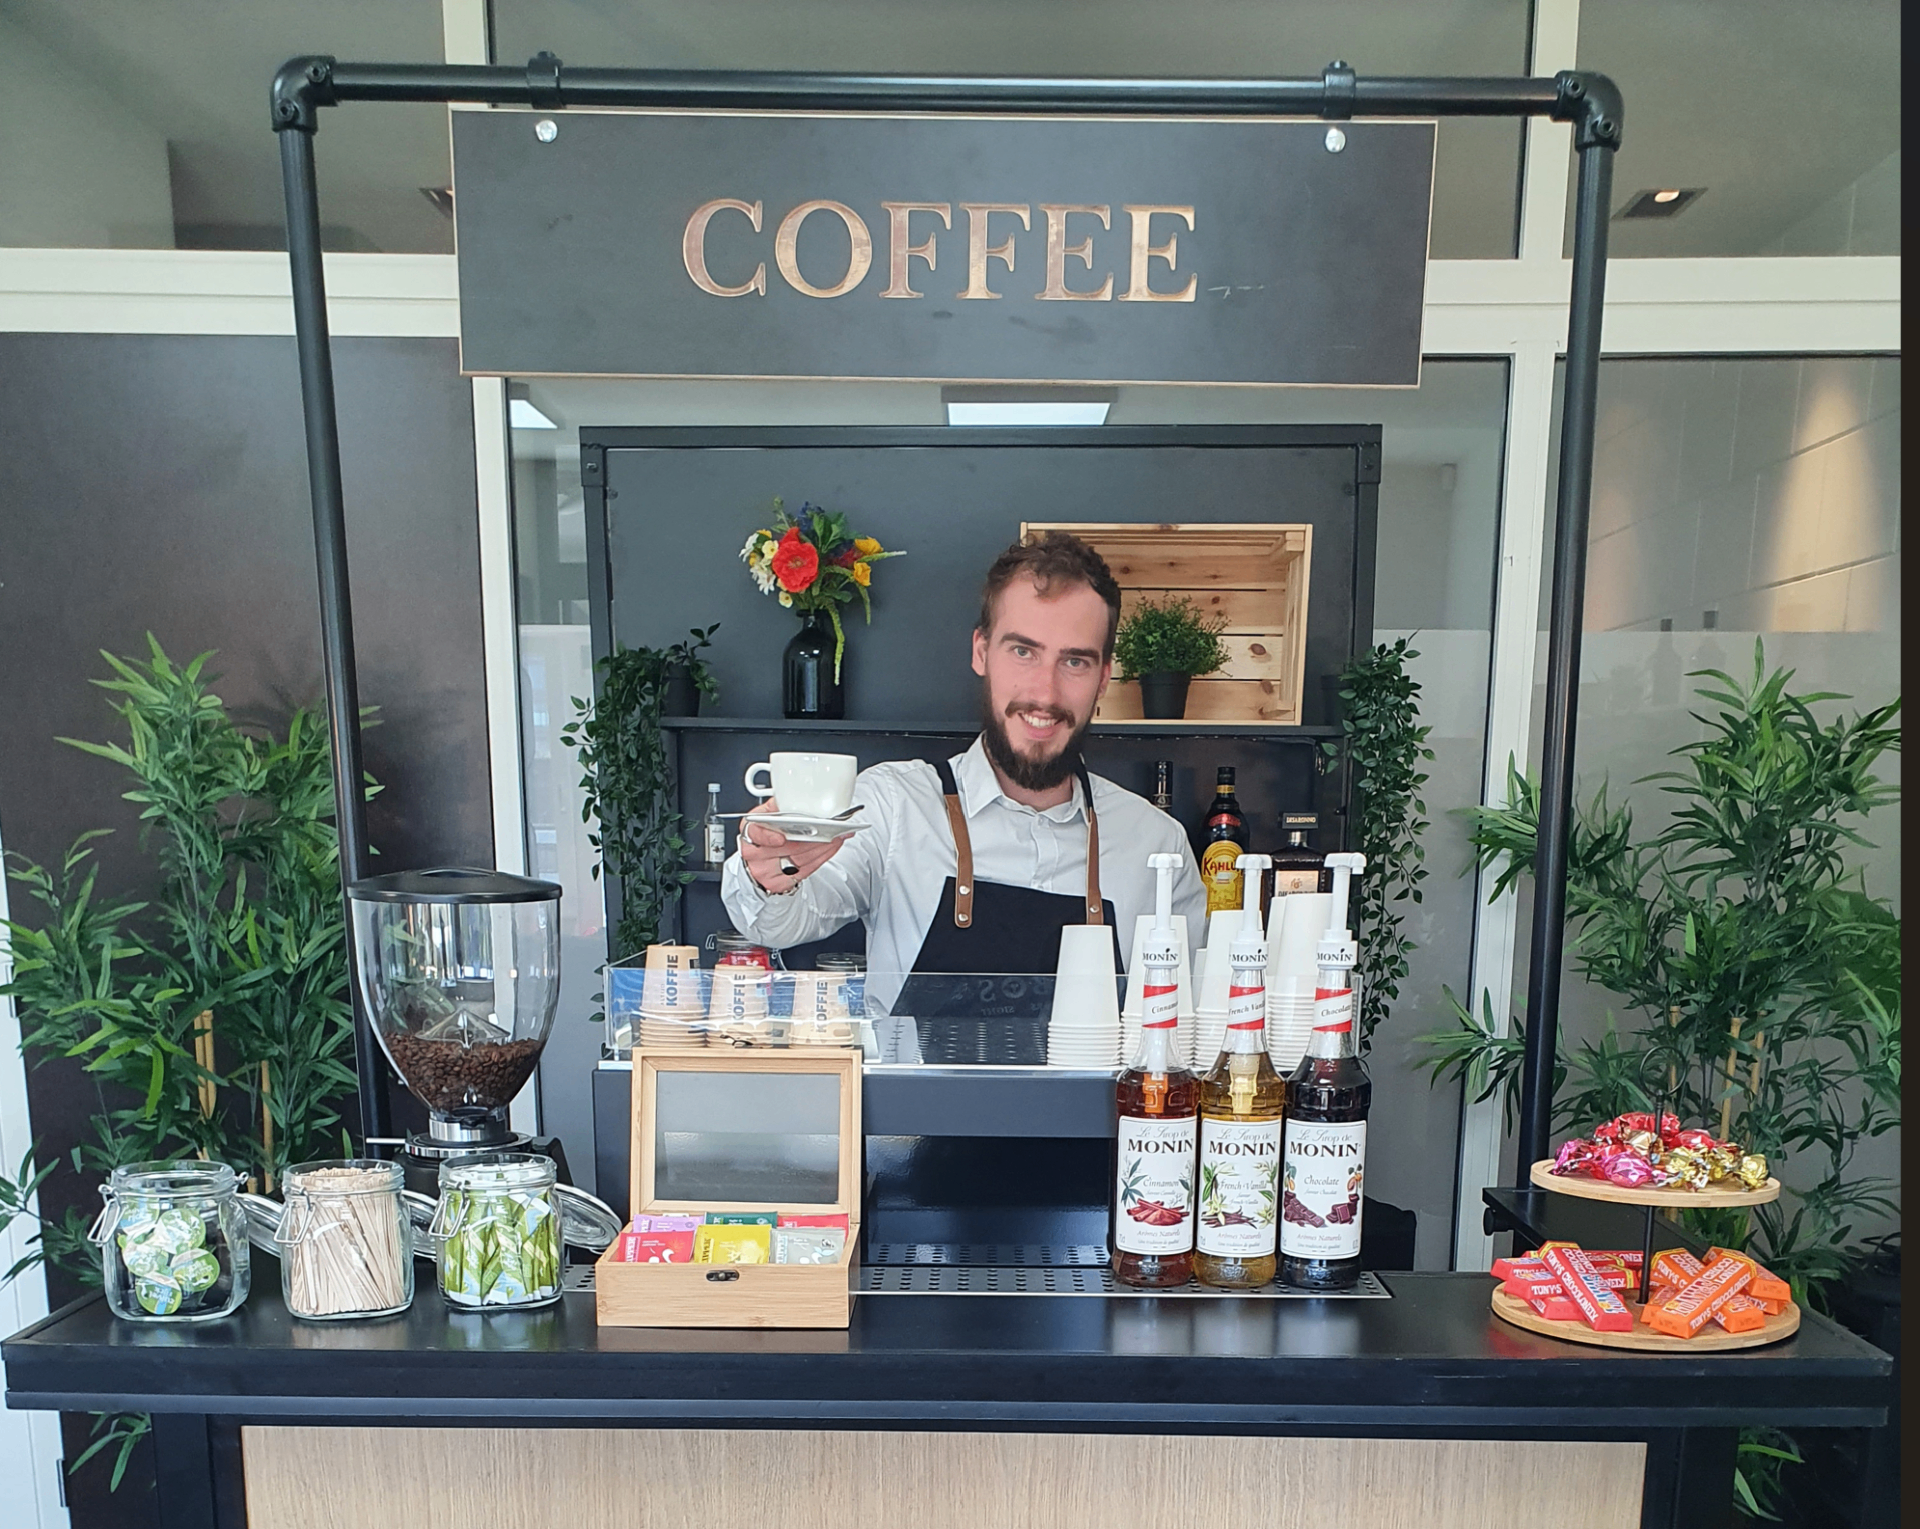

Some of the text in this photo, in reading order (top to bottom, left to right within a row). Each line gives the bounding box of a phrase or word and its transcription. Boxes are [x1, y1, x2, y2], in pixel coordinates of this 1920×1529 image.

[683, 198, 1198, 302] COFFEE
[1143, 950, 1176, 962] MONIN
[1232, 950, 1267, 963] MONIN
[1317, 950, 1351, 962] MONIN
[666, 954, 679, 1007] KOFFIE
[815, 981, 828, 1033] KOFFIE
[1128, 1138, 1193, 1154] MONIN
[1209, 1140, 1277, 1157] MONIN
[1290, 1140, 1359, 1158] MONIN
[1143, 1177, 1179, 1188] Cinnamon
[1304, 1174, 1340, 1186] Chocolate
[1531, 1284, 1562, 1295] TONY'S
